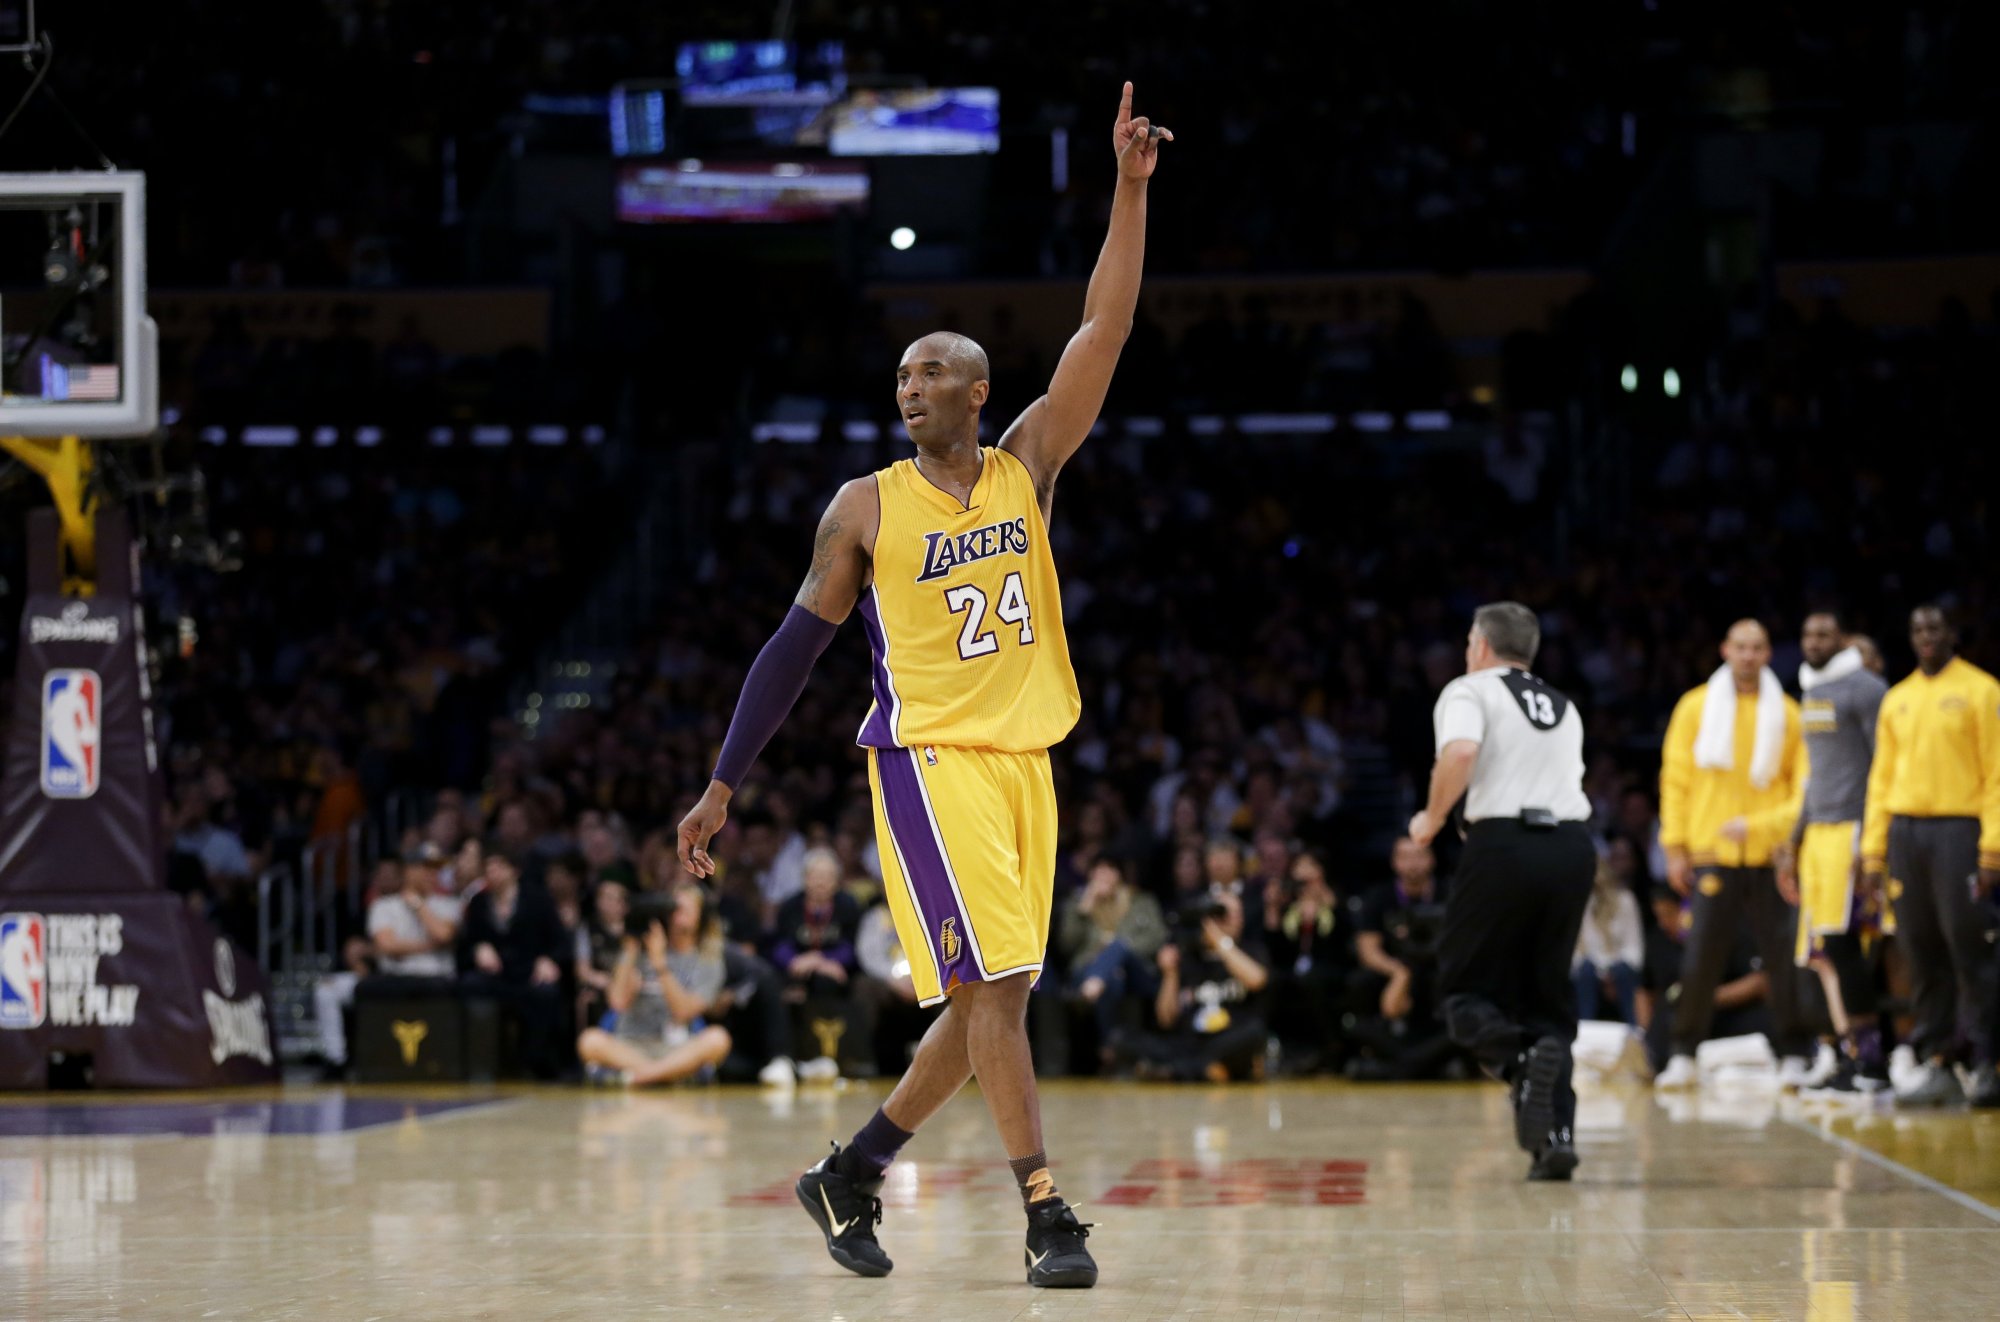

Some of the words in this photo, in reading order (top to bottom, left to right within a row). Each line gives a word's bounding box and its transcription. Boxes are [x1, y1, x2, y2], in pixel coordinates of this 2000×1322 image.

[915, 516, 1029, 583] LAKERS
[943, 570, 1035, 662] 24
[1521, 689, 1556, 725] 13
[47, 914, 98, 951] THIS
[98, 913, 123, 956] IS
[48, 951, 100, 986] WHY
[49, 986, 83, 1027] WE
[84, 984, 140, 1027] PLAY
